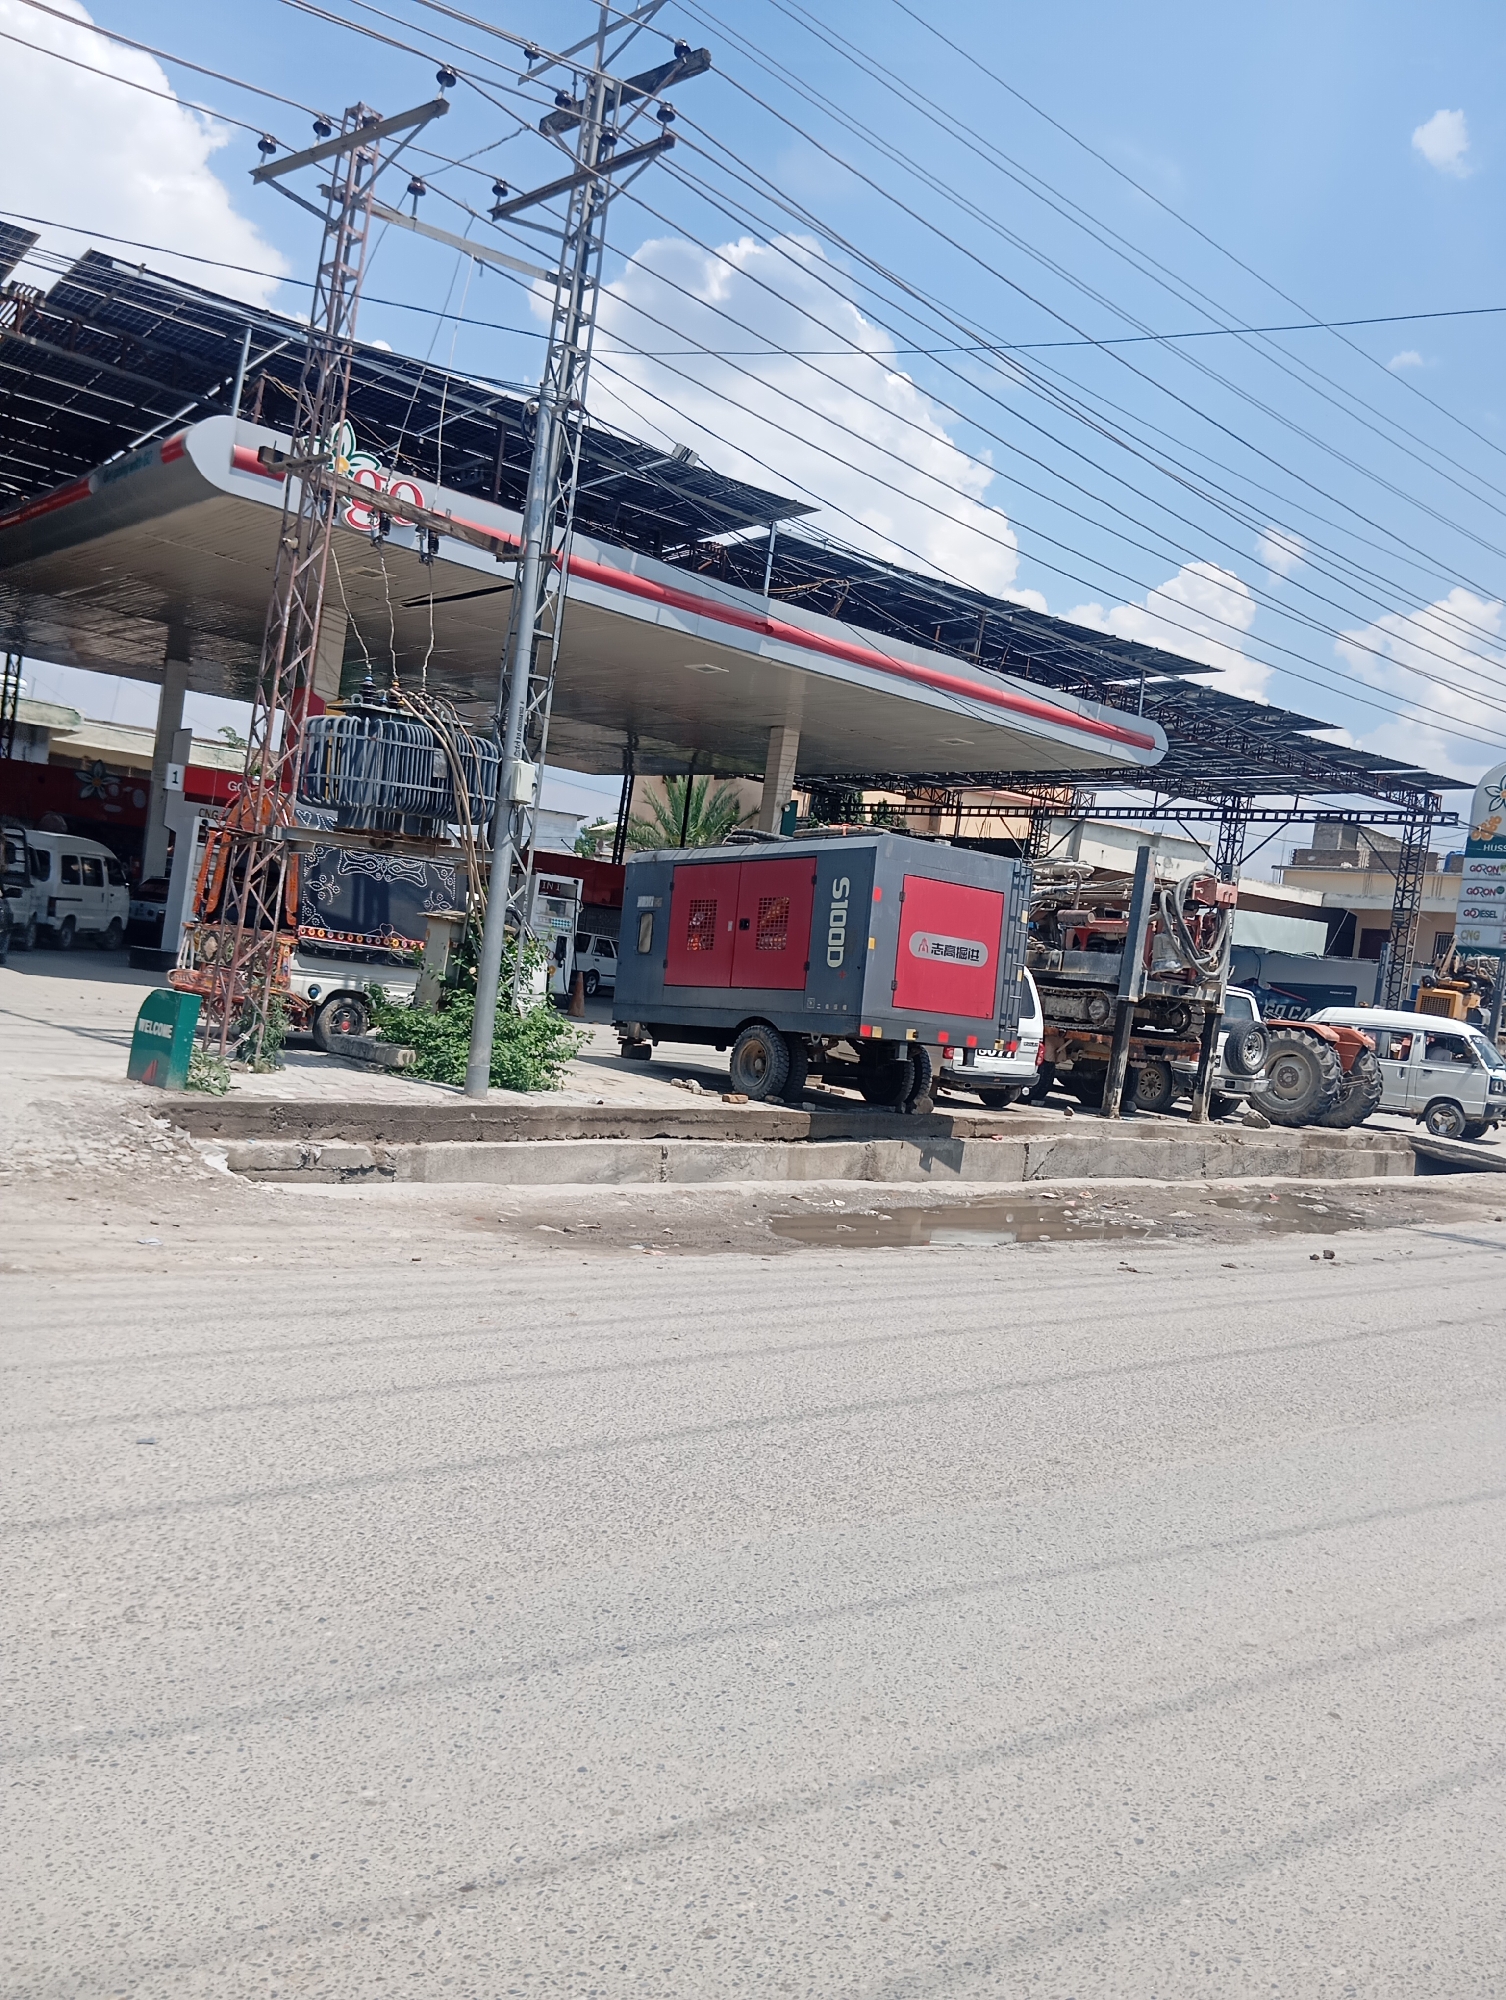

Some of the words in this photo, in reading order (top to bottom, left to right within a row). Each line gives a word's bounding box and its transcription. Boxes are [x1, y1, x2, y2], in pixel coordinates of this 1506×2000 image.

[346, 469, 424, 530] go
[172, 770, 179, 785] 1
[199, 808, 219, 819] CNG
[1469, 863, 1500, 874] GORON
[1466, 886, 1496, 898] GORON
[1461, 930, 1480, 941] CNG
[138, 1018, 174, 1039] WELCOME
